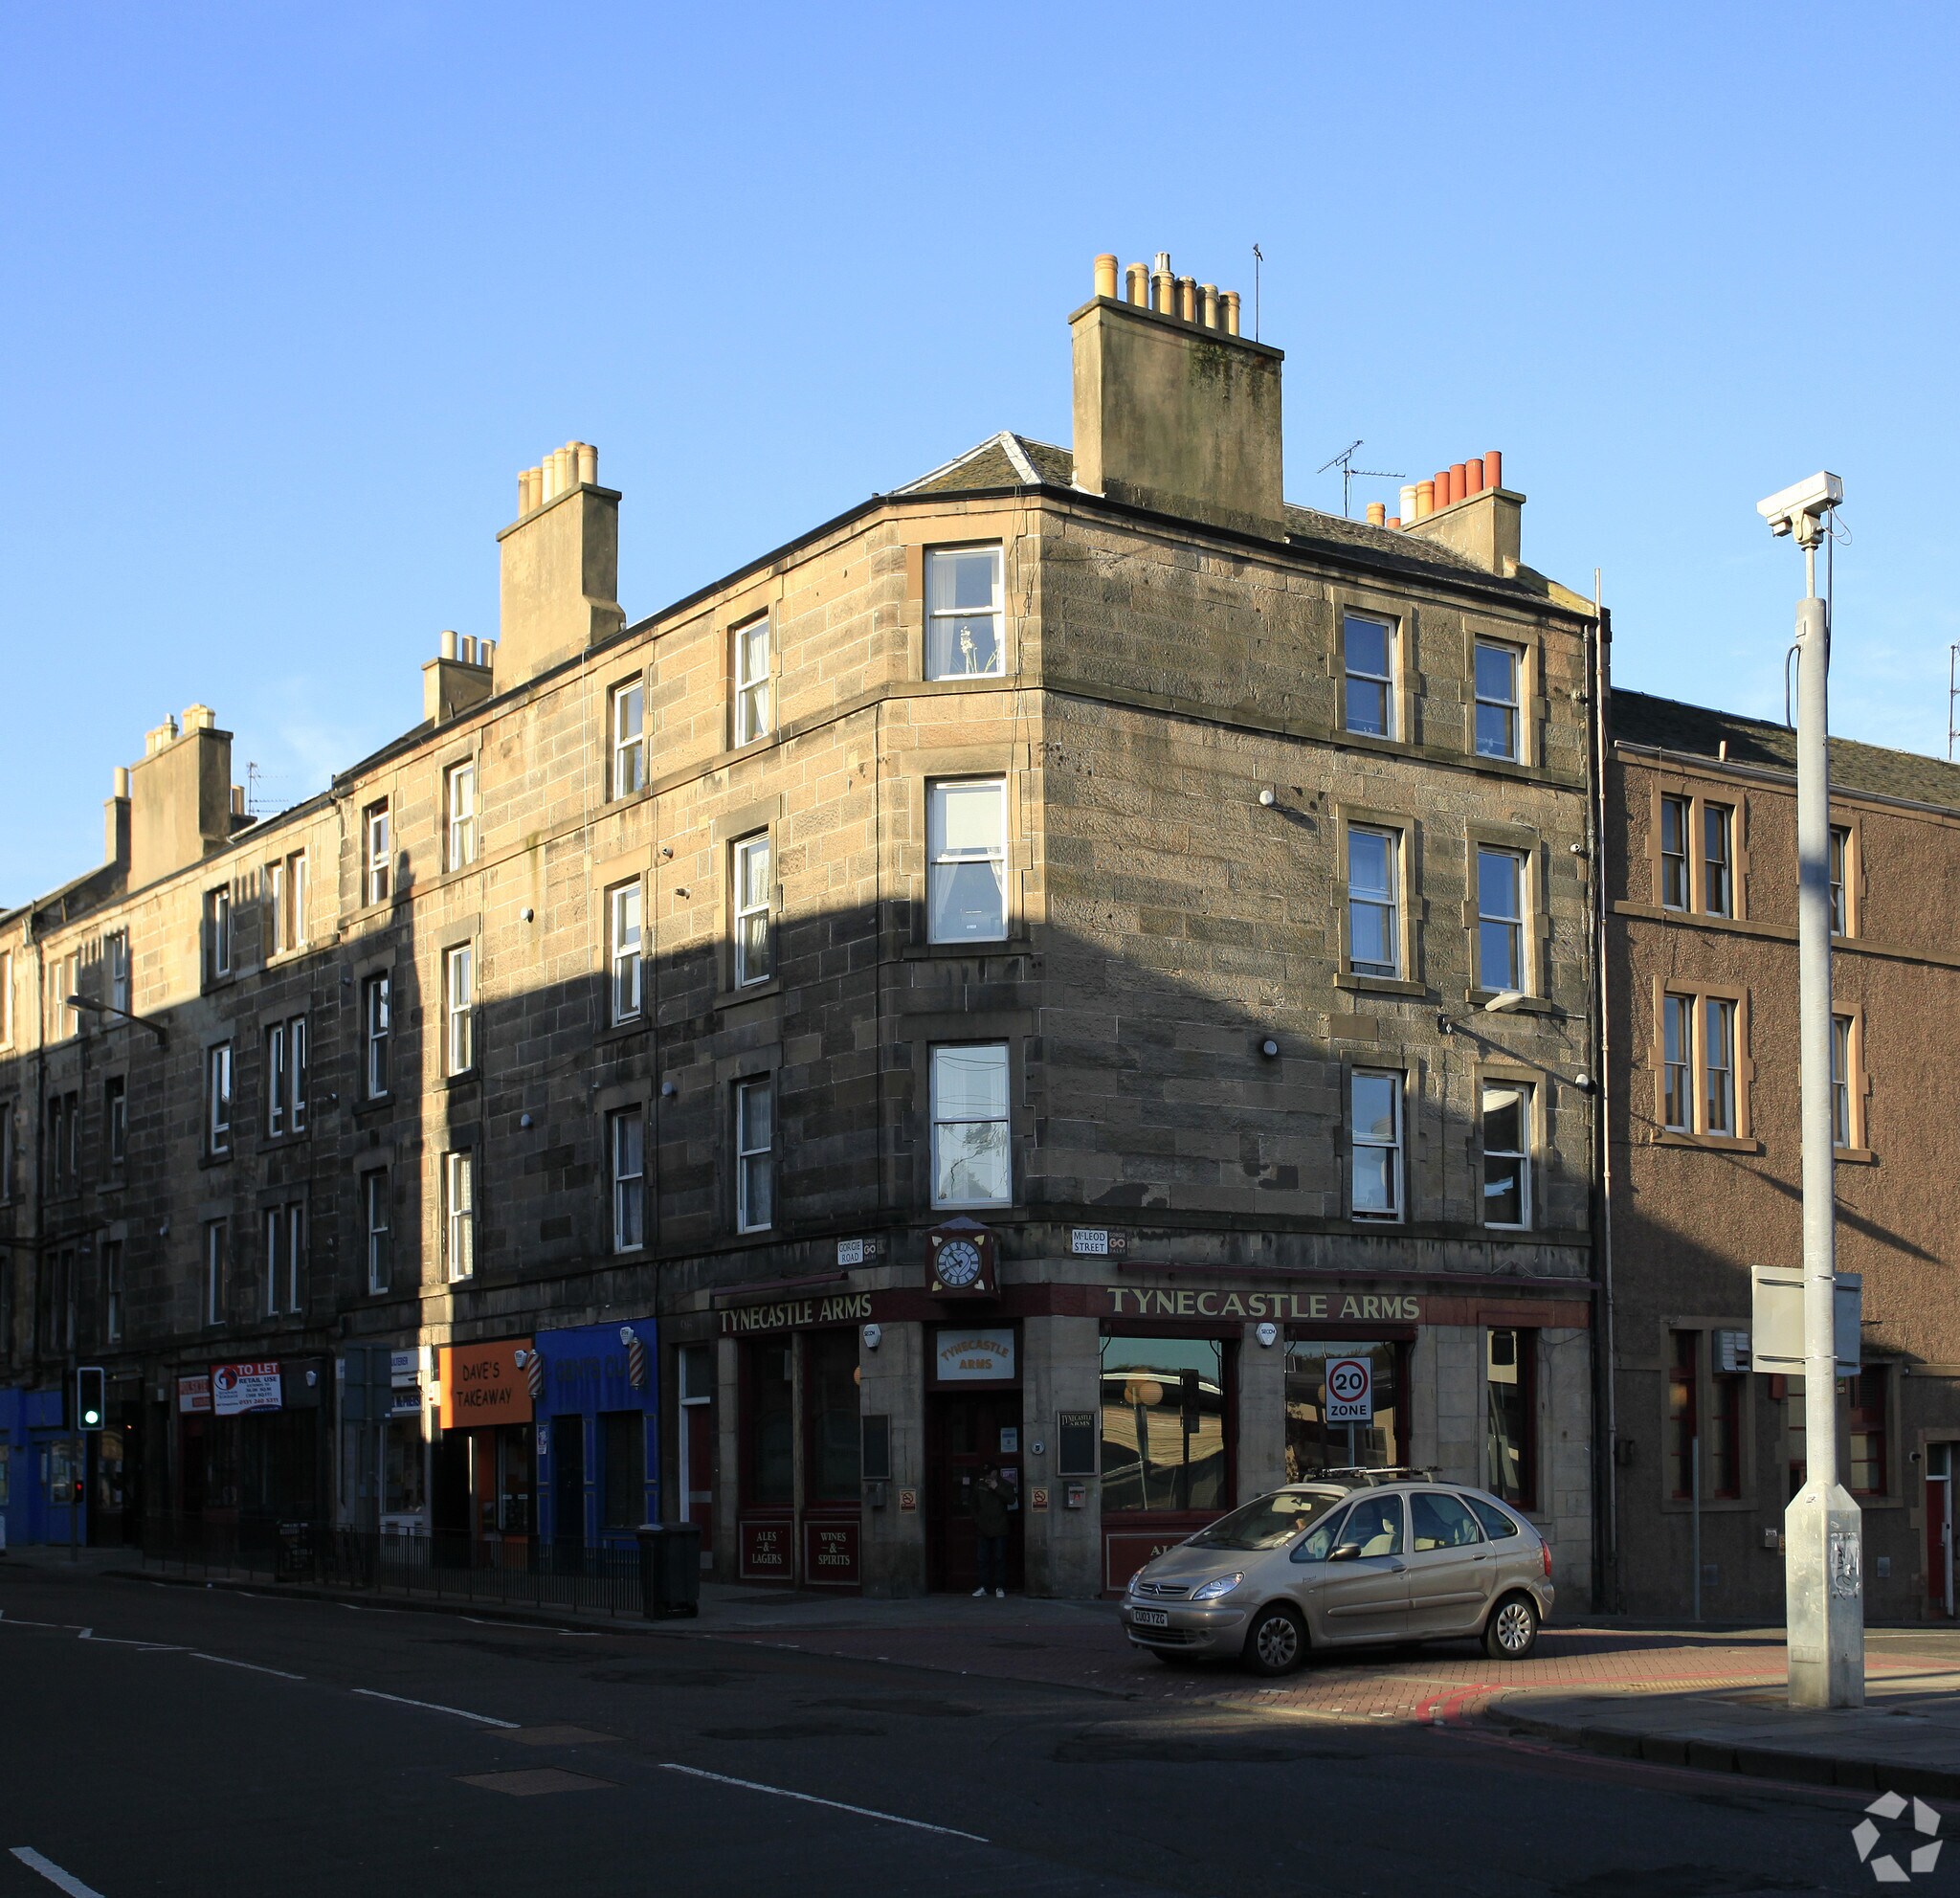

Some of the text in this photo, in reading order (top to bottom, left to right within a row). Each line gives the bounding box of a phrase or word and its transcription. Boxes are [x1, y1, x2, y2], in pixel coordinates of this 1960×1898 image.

[1074, 1232, 1105, 1241] McLEOD
[838, 1241, 860, 1252] GORGIE
[1075, 1242, 1104, 1252] STREET
[1109, 1239, 1125, 1248] GO
[864, 1244, 876, 1255] GO
[842, 1253, 858, 1262] ROAD
[1106, 1287, 1420, 1320] TYNECASTLE ARMS
[720, 1294, 872, 1332] TYNECASTLE ARMS
[941, 1340, 1010, 1361] TYNECASTLE
[237, 1362, 278, 1375] TO LET
[959, 1358, 993, 1370] ARMS
[462, 1361, 501, 1381] DAVE'S
[1335, 1373, 1363, 1391] 20
[457, 1388, 512, 1407] TAKEAWAY
[1331, 1405, 1367, 1416] ZONE
[1061, 1415, 1092, 1426] TYNECASTLE
[756, 1531, 777, 1542] ALES
[820, 1532, 846, 1542] WINES
[763, 1542, 769, 1552] &
[829, 1542, 836, 1553] &
[752, 1553, 782, 1564] LAGERS
[817, 1554, 851, 1565] SPIRITS
[1135, 1611, 1165, 1624] CU03 YZG
